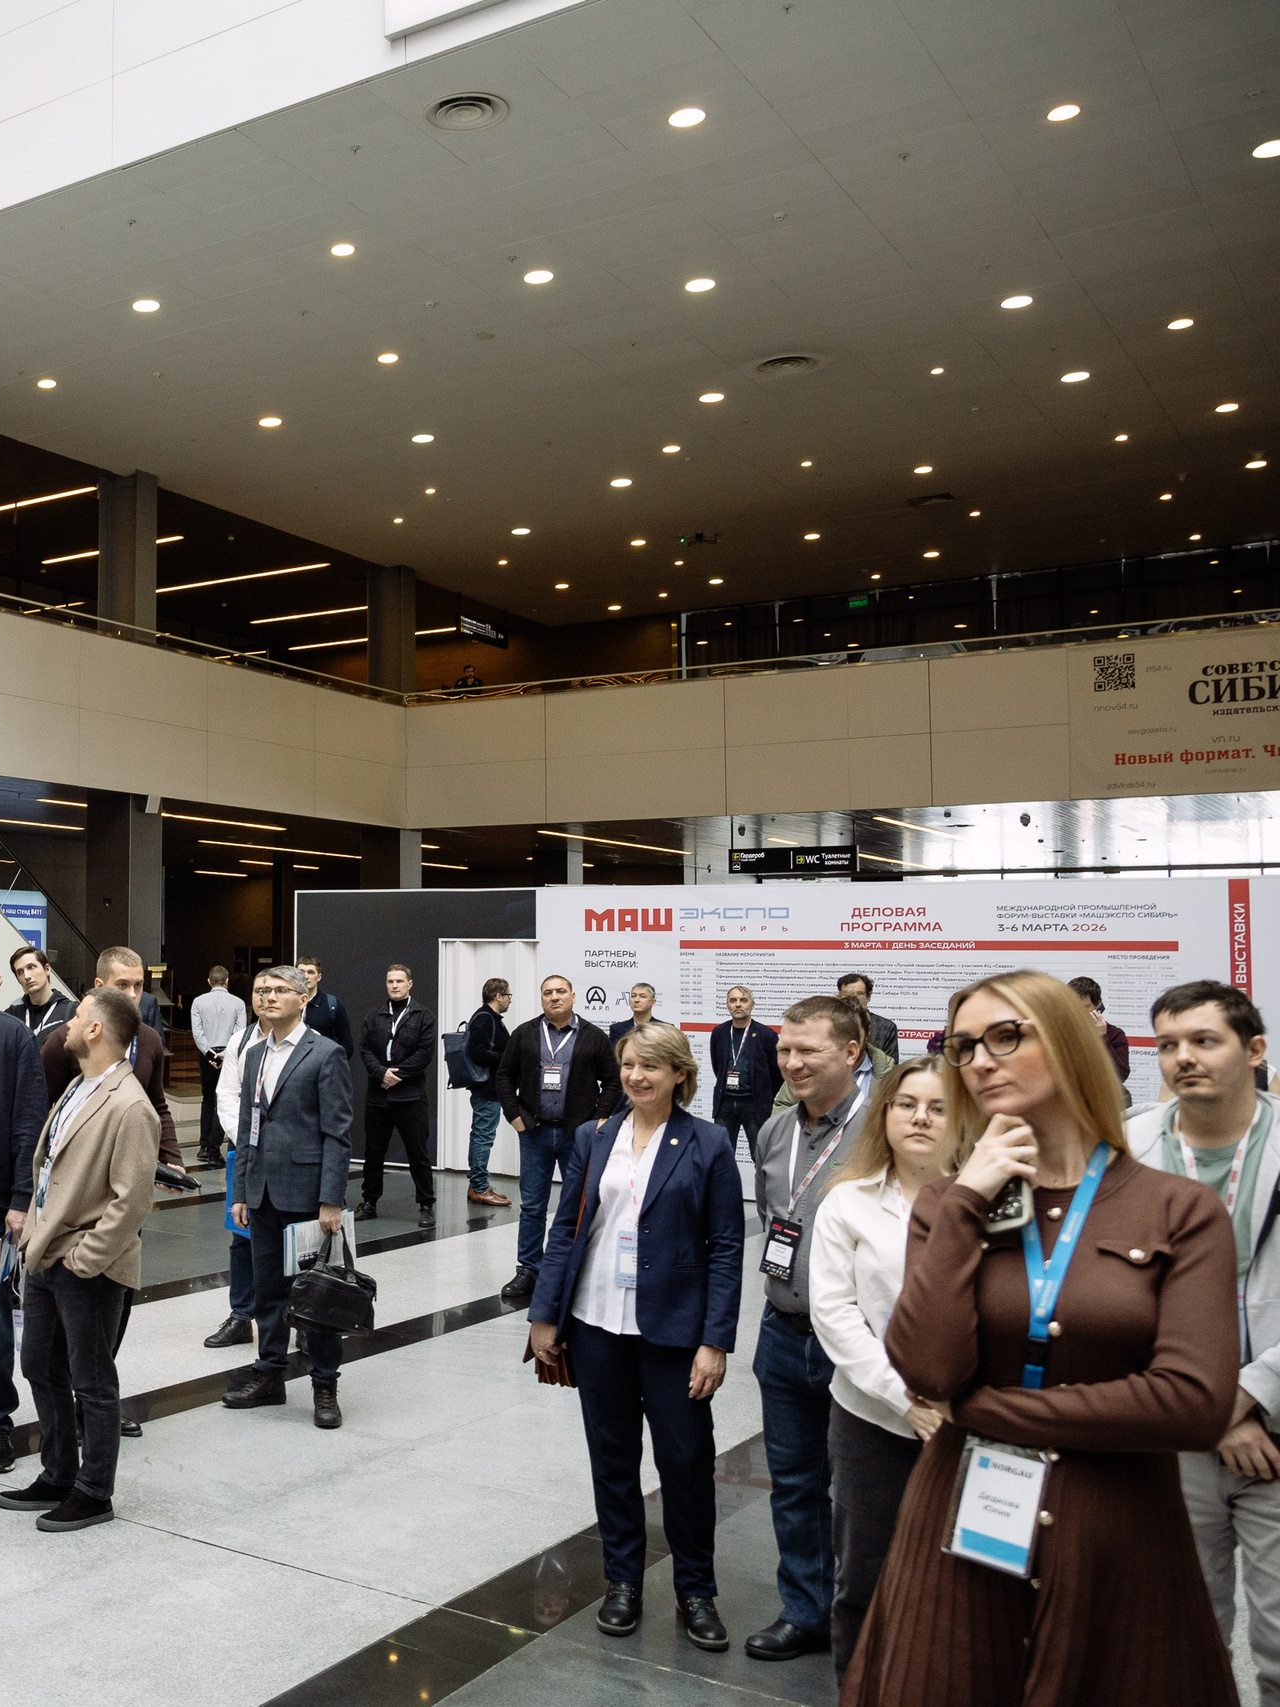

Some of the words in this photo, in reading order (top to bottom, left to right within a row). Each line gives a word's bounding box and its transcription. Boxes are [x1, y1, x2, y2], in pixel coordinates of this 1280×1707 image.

[1202, 660, 1280, 676] СОВЕТС
[1188, 674, 1280, 705] СИБИ
[1212, 704, 1280, 716] издательск
[1212, 735, 1240, 744] vn.ru
[1114, 750, 1173, 766] Новый
[1180, 749, 1256, 765] формат.
[805, 855, 820, 864] WC
[679, 907, 789, 919] ЭКСПО
[851, 907, 926, 919] ДЕЛОВАЯ
[996, 904, 1076, 912] МЕЖДУНАРОДНОЙ
[1077, 903, 1157, 911] ПРОМЫШЛЕННОЙ
[585, 908, 672, 932] МАШ
[840, 922, 943, 932] ПРОГРАММА
[997, 923, 1019, 932] 3-6
[1022, 923, 1069, 932] МАРТА
[1072, 923, 1107, 932] 2026
[919, 941, 976, 949] ЗАСЕДАНИЙ
[1234, 903, 1247, 984] ВЫСТАВКИ
[585, 950, 637, 958] ПАРТНЕРЫ
[585, 960, 638, 968] ВЫСТАВКИ:
[991, 1462, 1036, 1479] NORGAU
